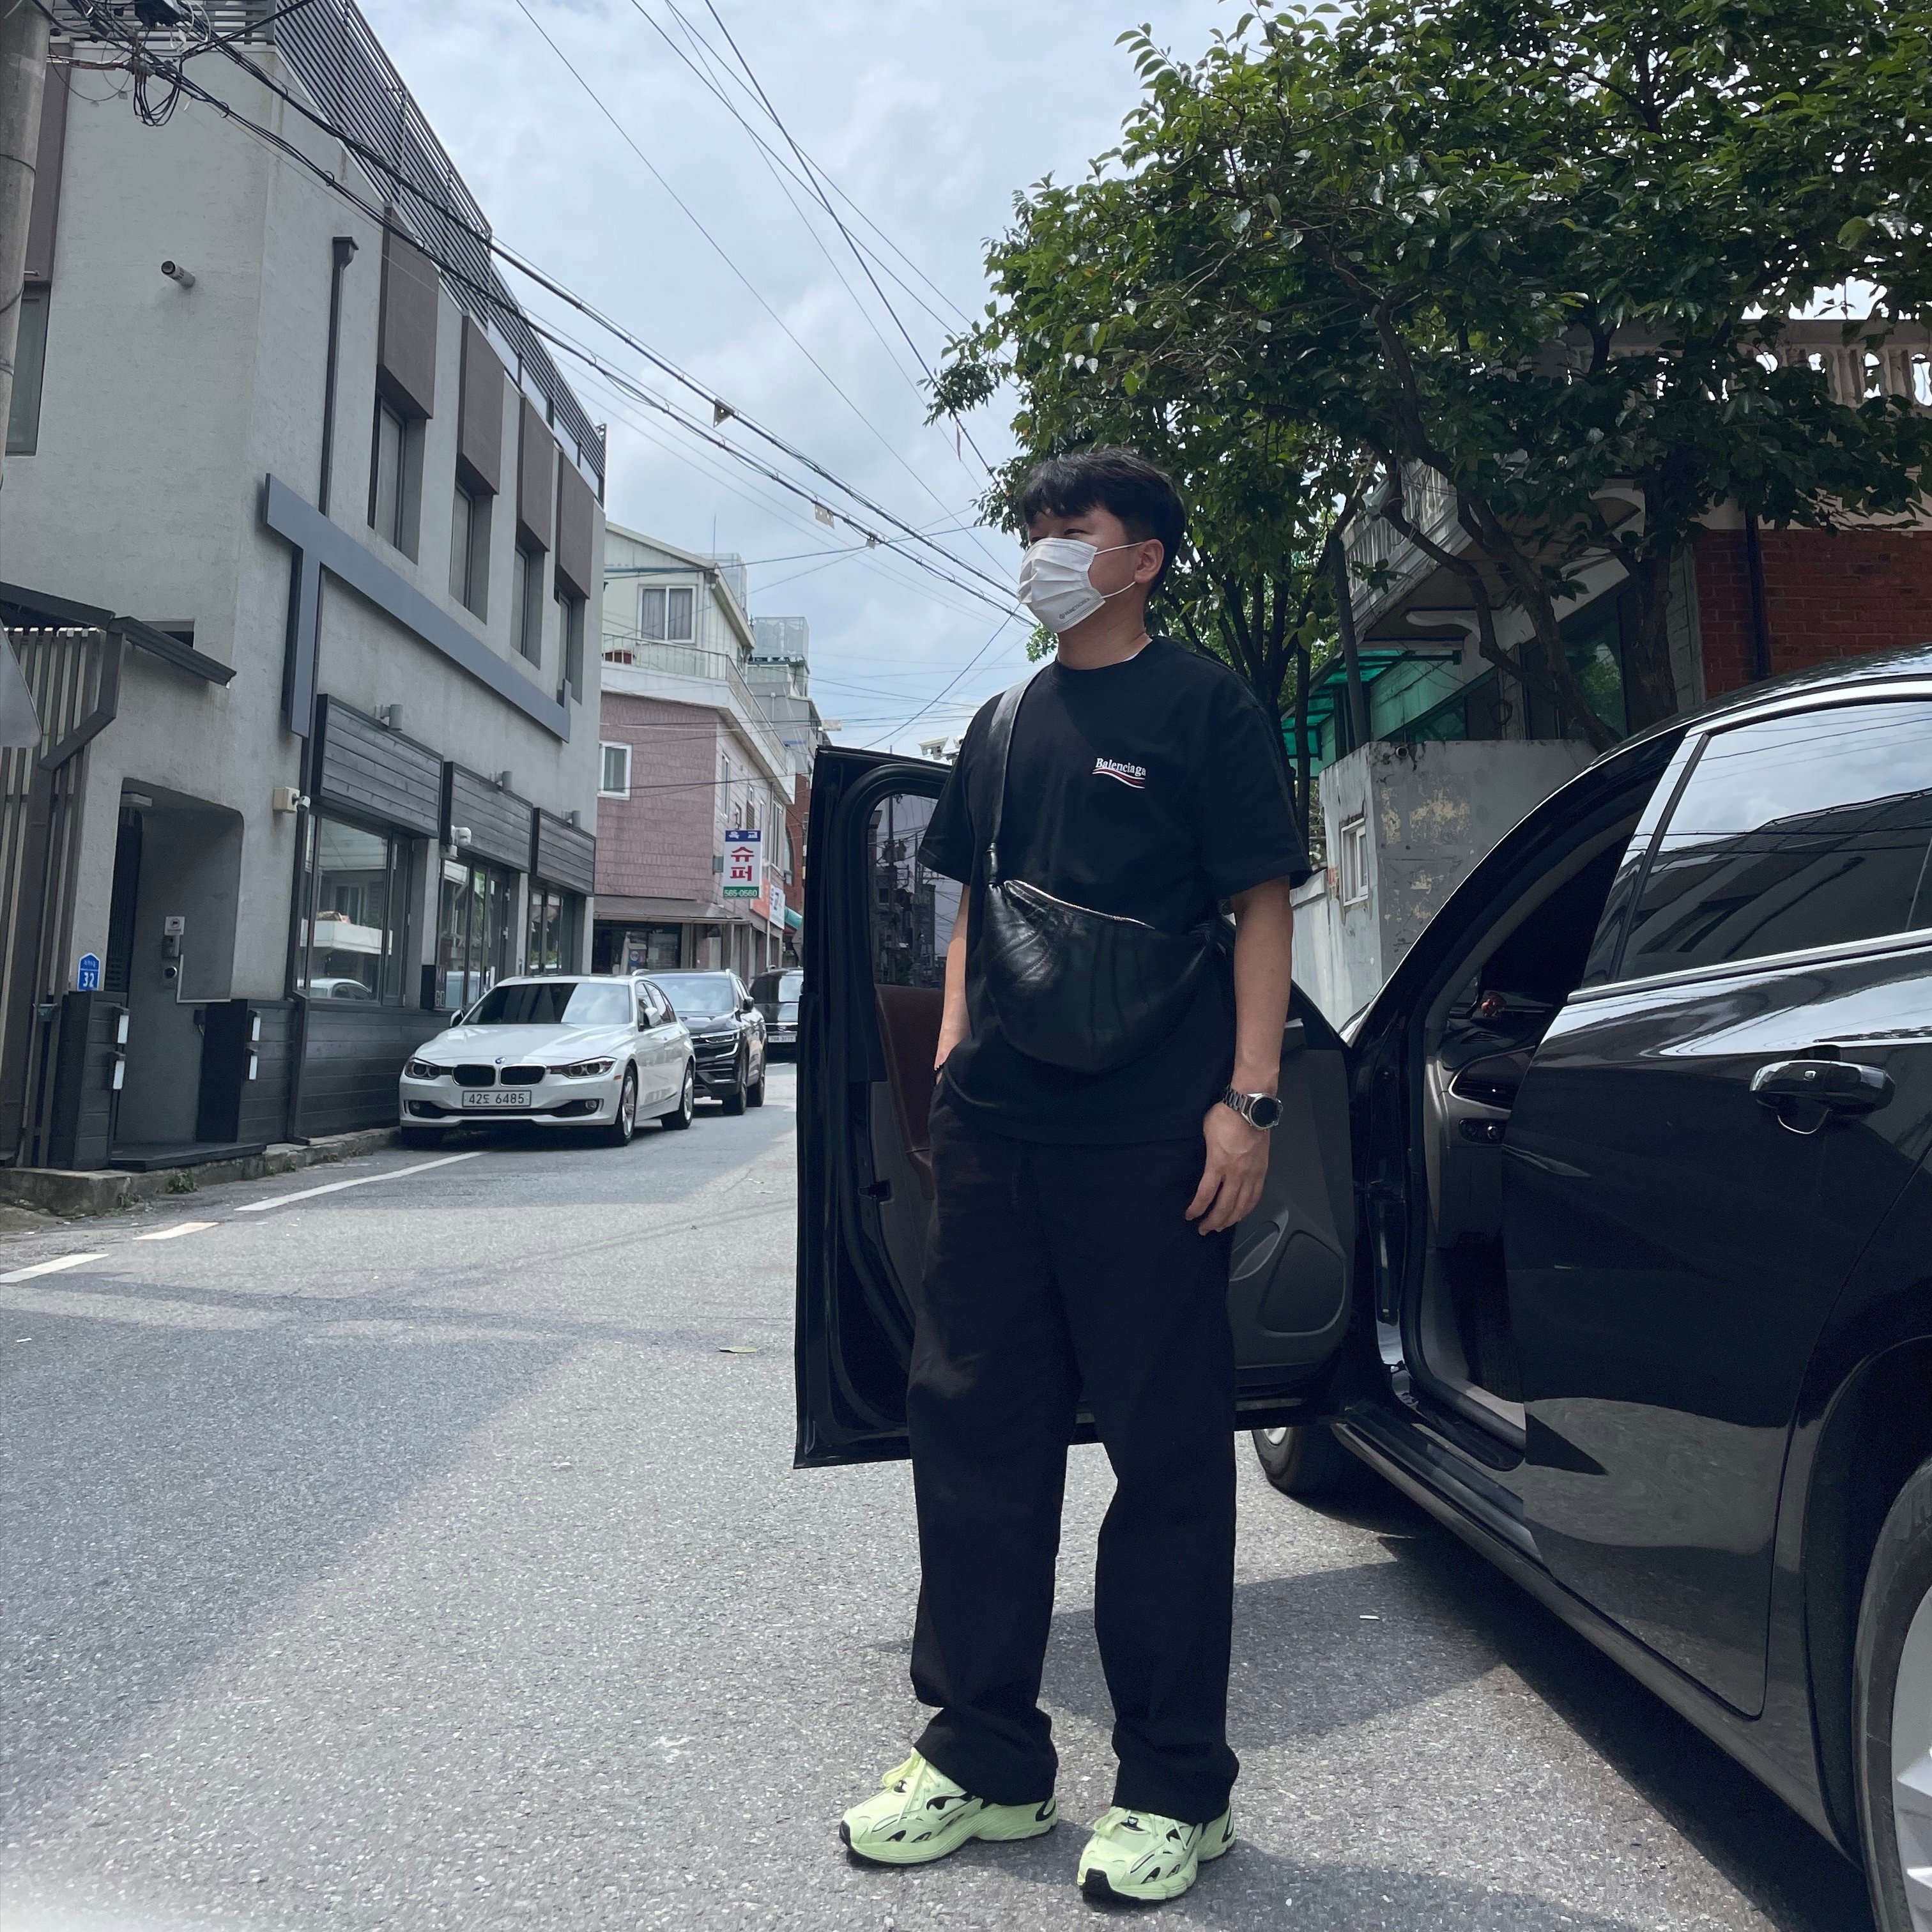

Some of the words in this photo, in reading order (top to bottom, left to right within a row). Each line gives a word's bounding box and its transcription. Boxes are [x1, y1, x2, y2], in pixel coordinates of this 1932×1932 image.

[1095, 758, 1146, 777] Balenciaga
[730, 846, 755, 882] 슈퍼
[82, 972, 95, 988] 32
[468, 1093, 490, 1105] 42도
[495, 1093, 525, 1104] 6485
